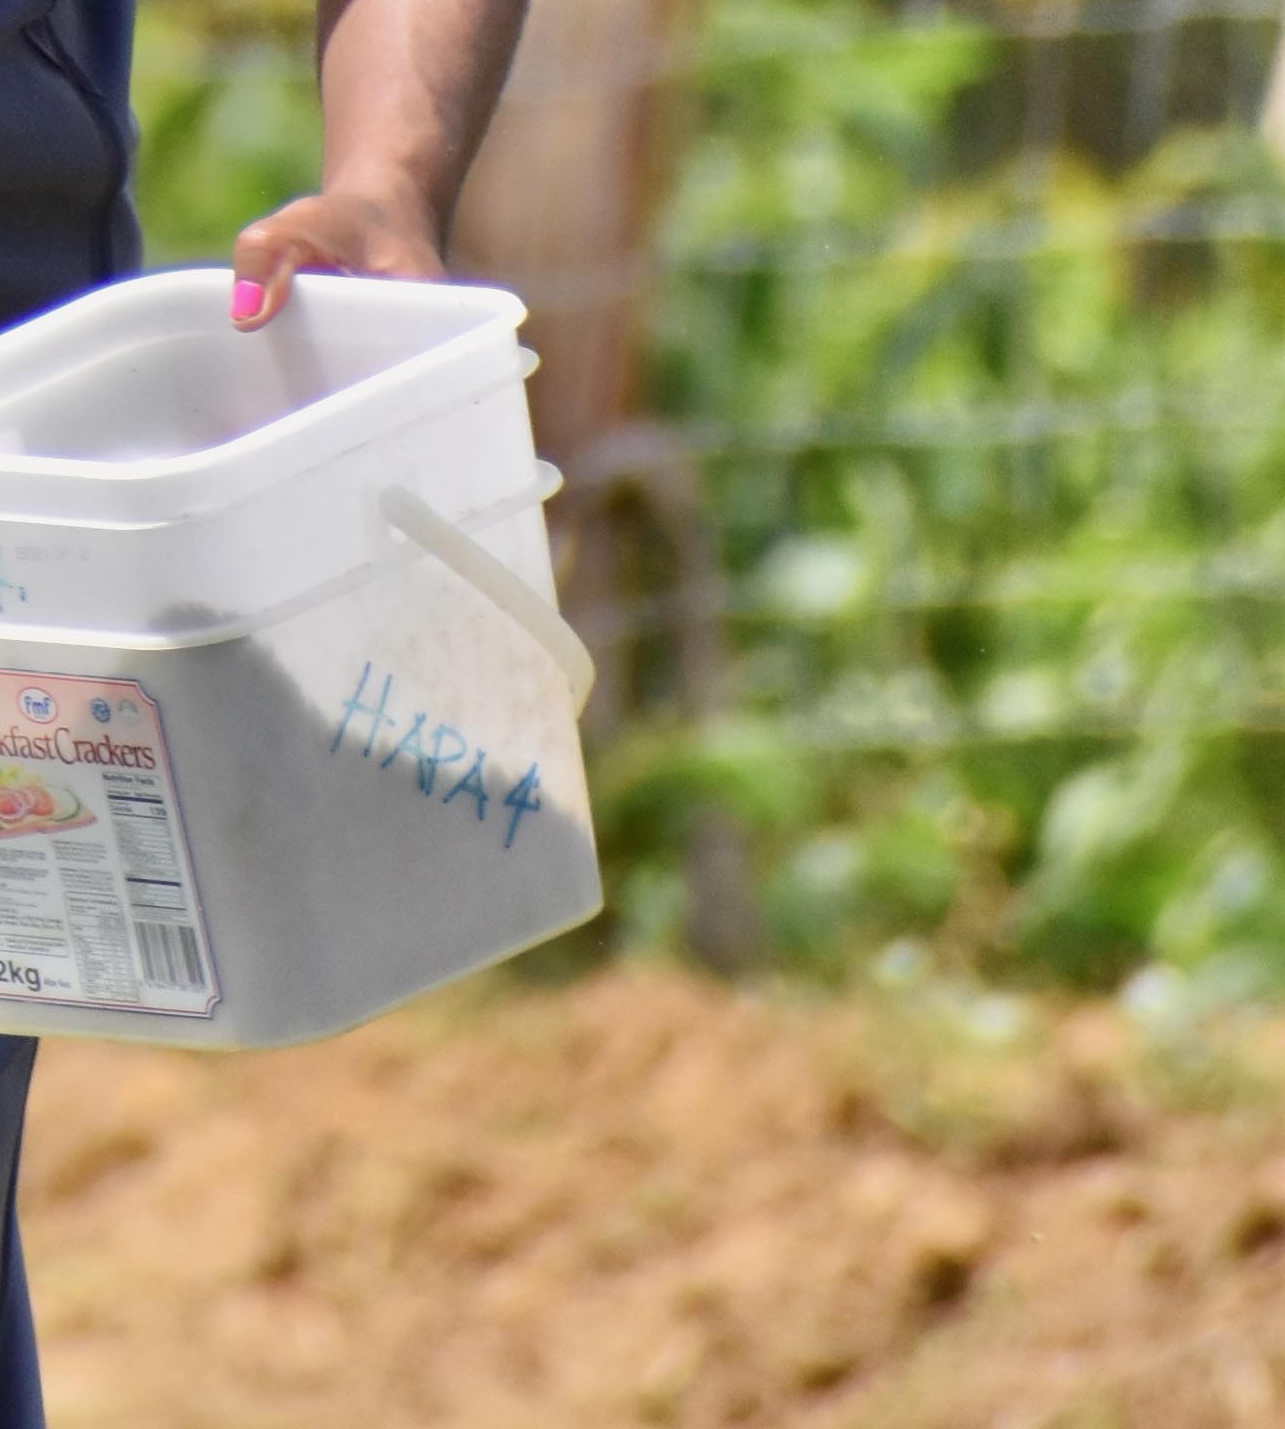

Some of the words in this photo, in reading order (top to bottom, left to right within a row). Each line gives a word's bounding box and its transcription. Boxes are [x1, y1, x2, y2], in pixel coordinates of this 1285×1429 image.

[23, 694, 51, 715] fmf
[54, 727, 156, 769] Crackers
[330, 660, 489, 821] HAPA
[502, 761, 541, 849] 4
